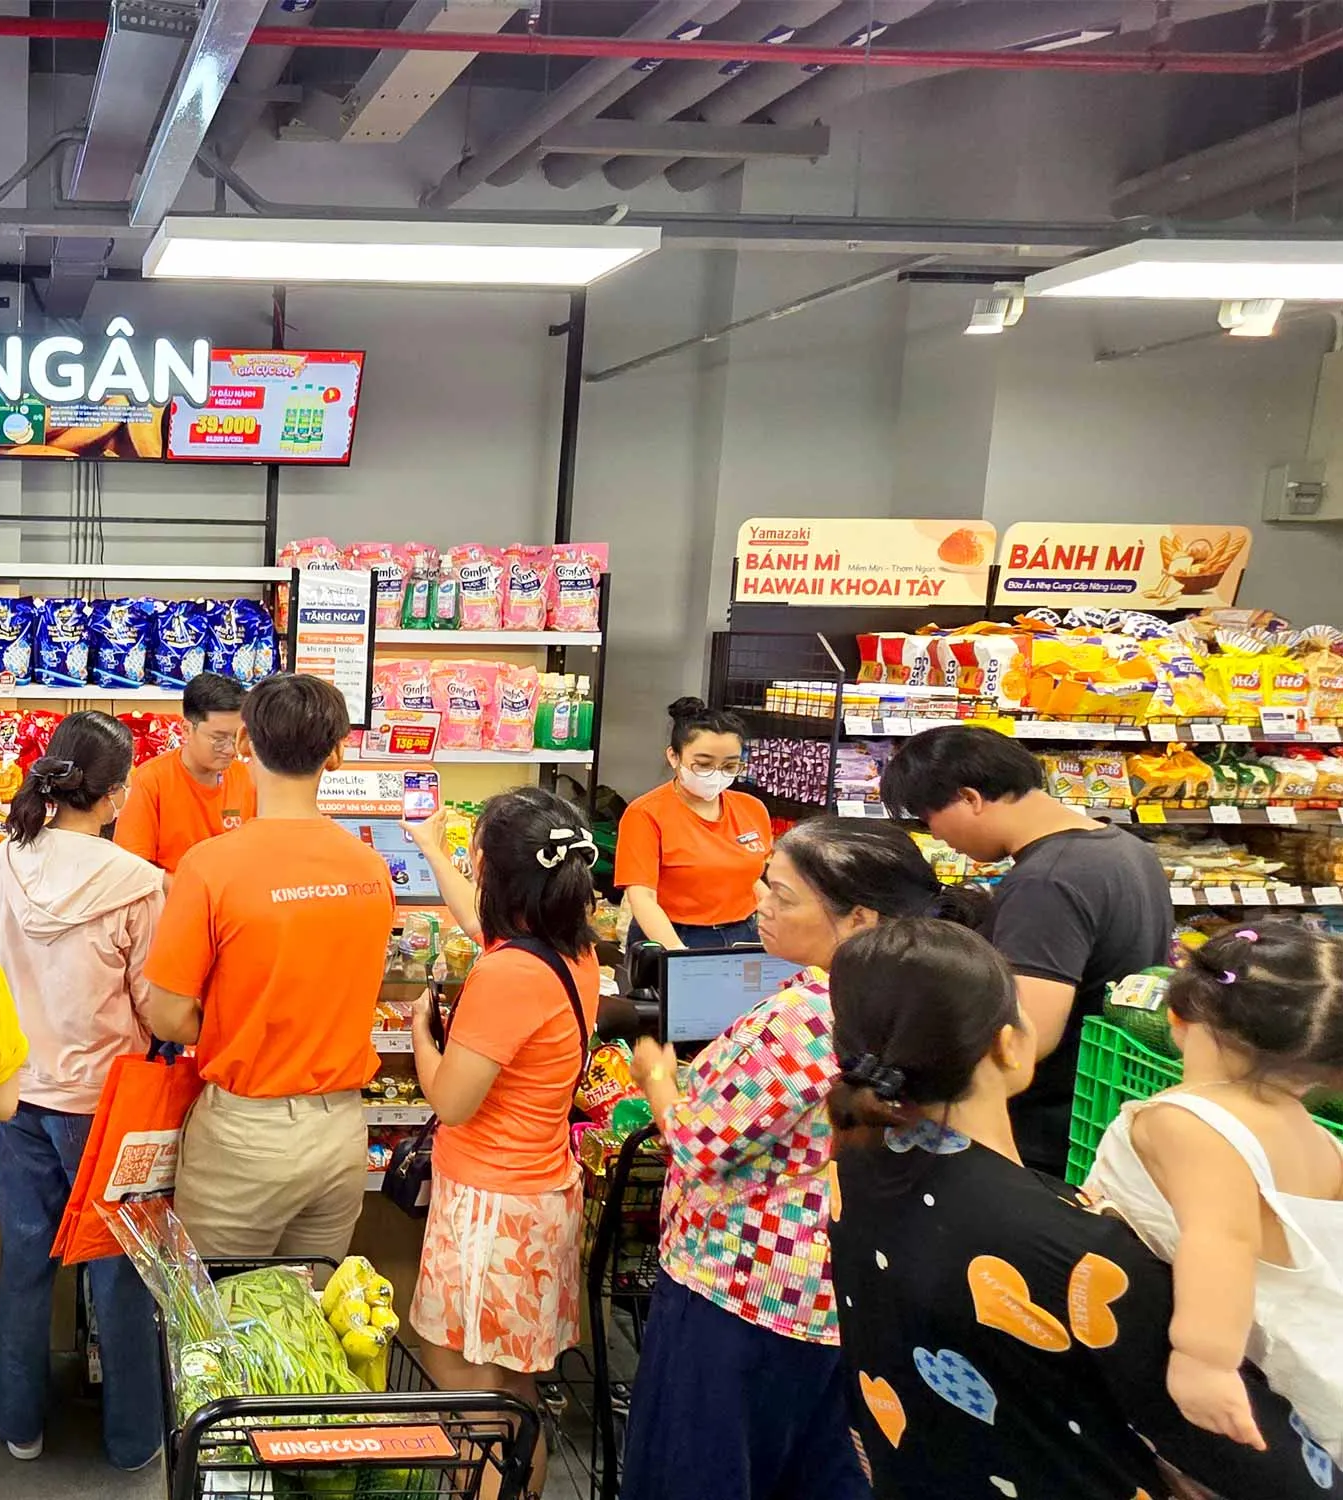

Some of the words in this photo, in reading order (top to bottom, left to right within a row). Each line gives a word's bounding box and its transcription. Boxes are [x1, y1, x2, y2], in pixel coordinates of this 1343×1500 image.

[196, 415, 257, 434] 39.000
[750, 526, 811, 540] Yamazaki
[746, 549, 808, 571] BÁNH
[814, 549, 841, 571] MÌ
[1008, 538, 1099, 570] BÁNH
[1105, 539, 1145, 571] MÌ
[556, 565, 591, 578] Comfort
[743, 577, 824, 596] HAWAII
[830, 577, 901, 596] KHOAI
[907, 575, 946, 597] TÂY
[1052, 581, 1072, 591] Cung
[305, 610, 332, 623] TẶNG
[333, 612, 361, 622] NGAY
[323, 775, 365, 785] OneLife
[319, 788, 345, 796] HÀNH
[348, 788, 367, 796] VIÊN
[271, 879, 383, 903] KINGFOODmart
[269, 1433, 436, 1457] KINGFOODmart
